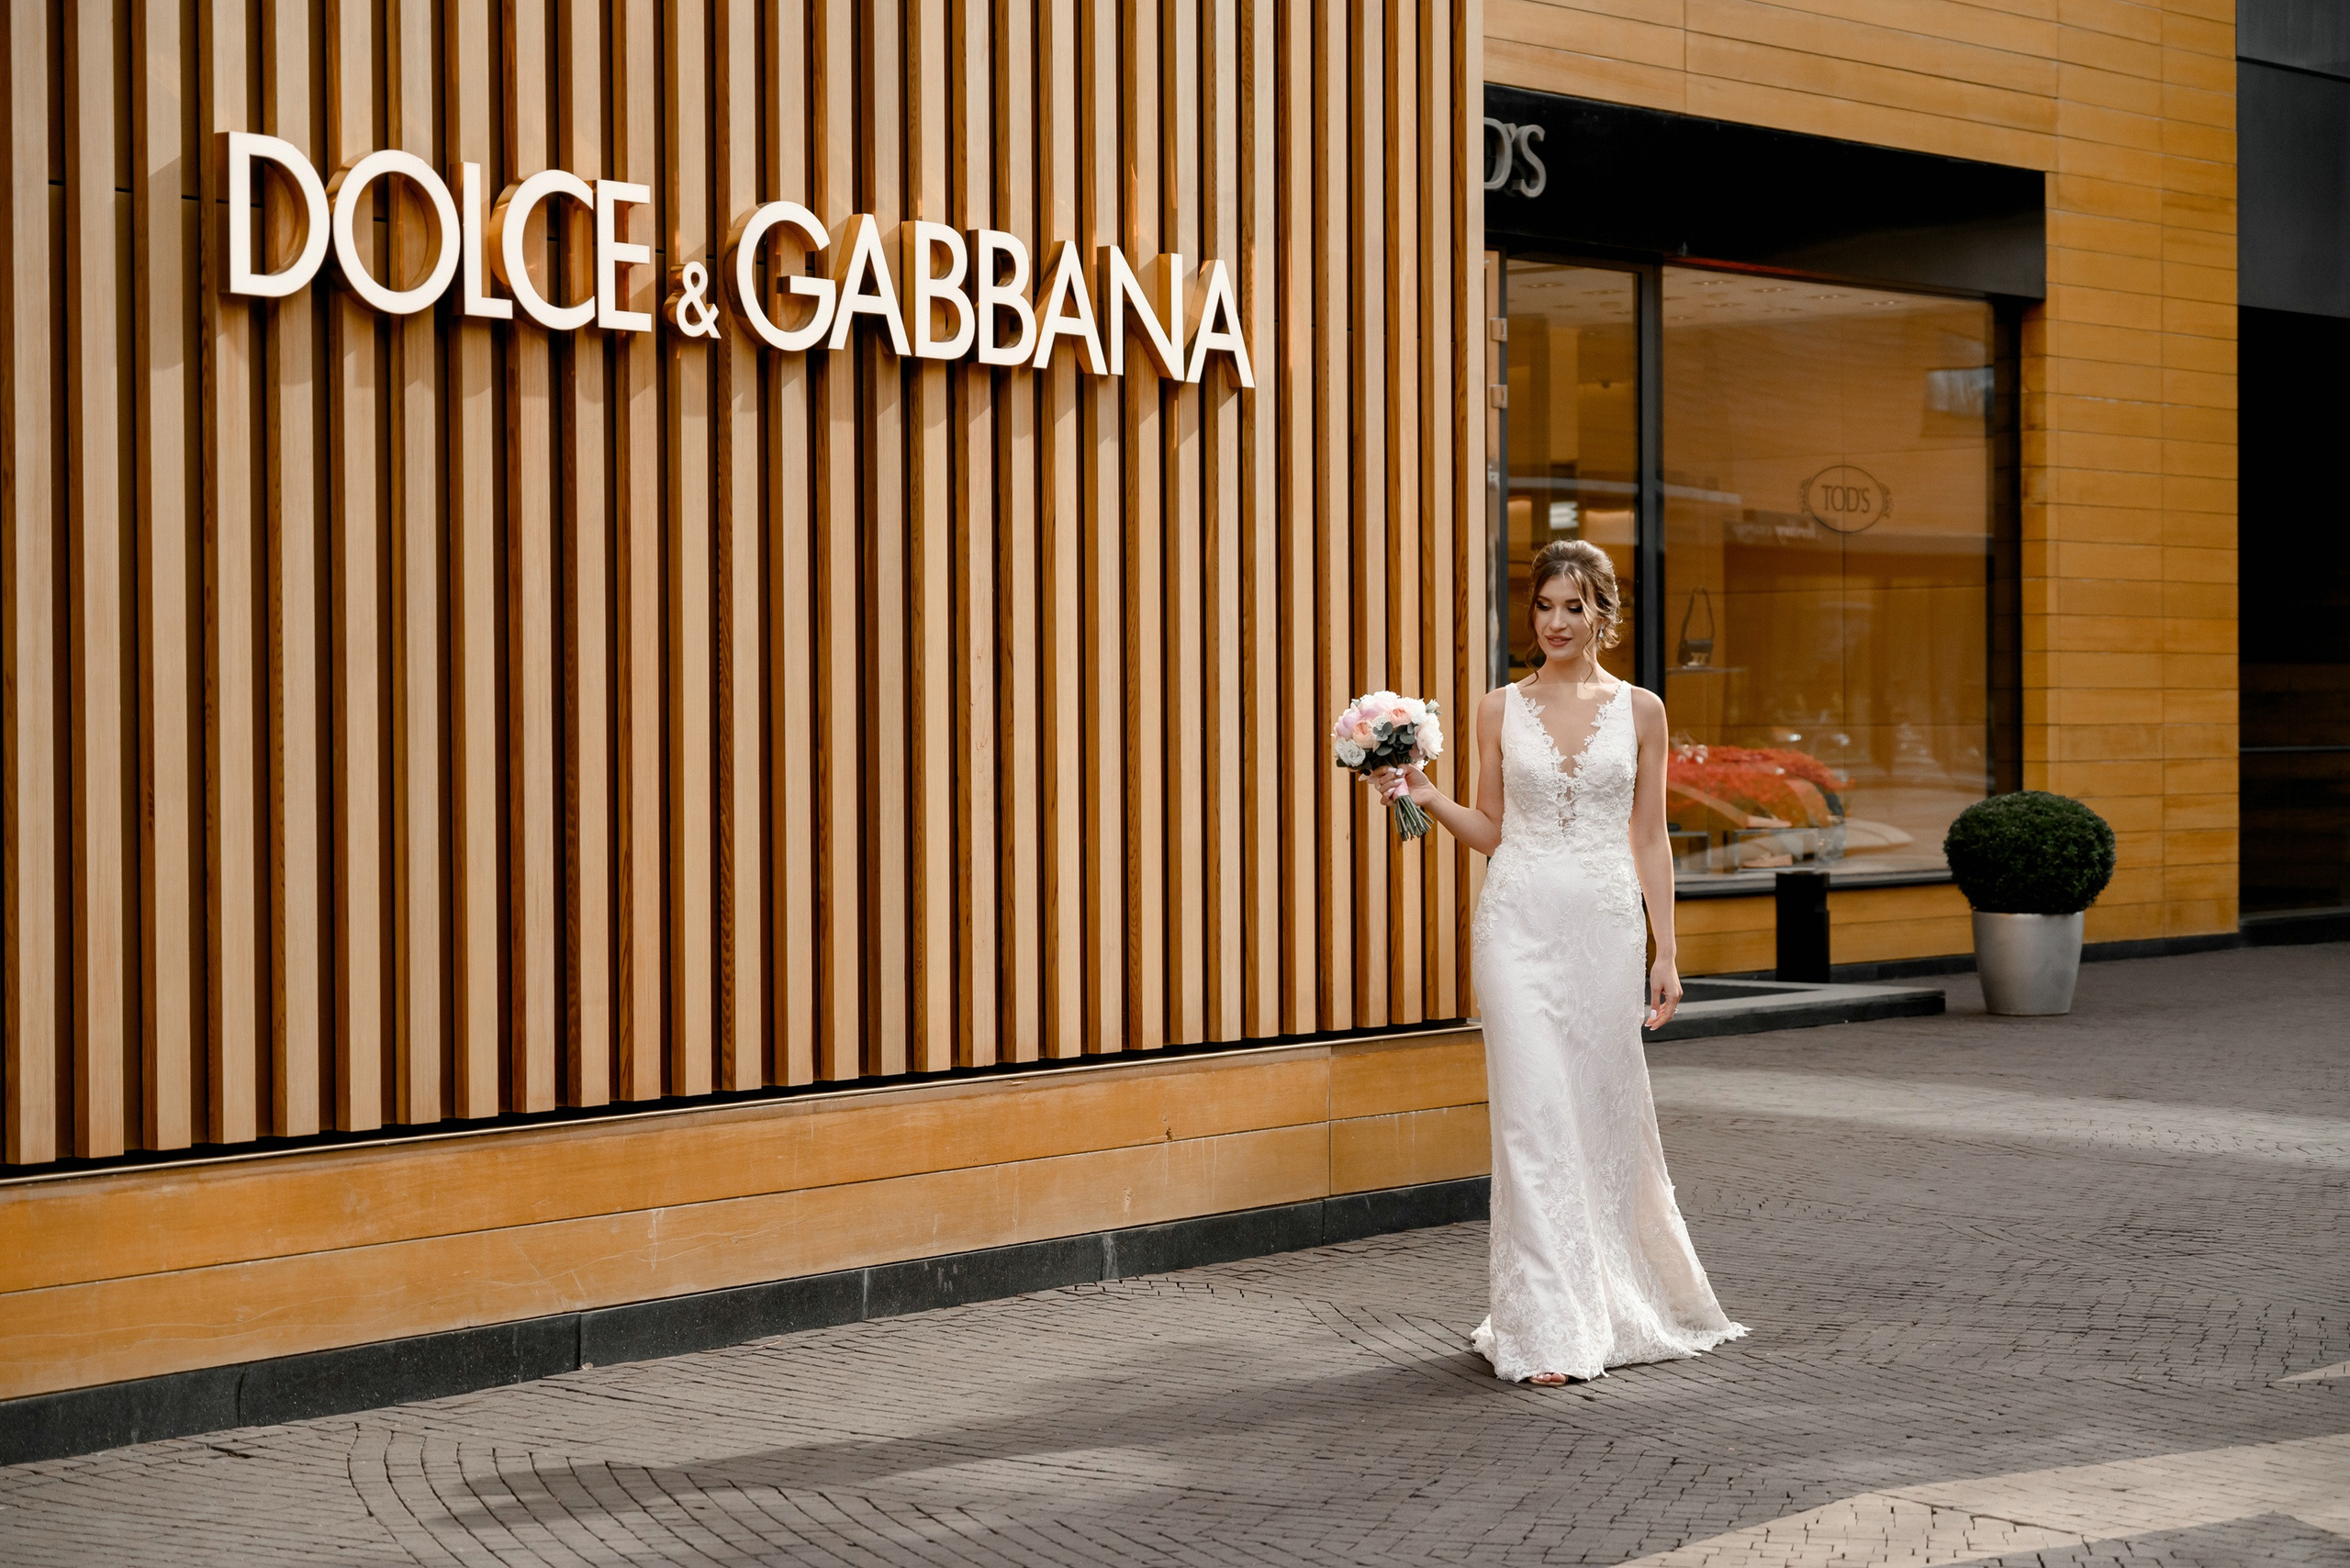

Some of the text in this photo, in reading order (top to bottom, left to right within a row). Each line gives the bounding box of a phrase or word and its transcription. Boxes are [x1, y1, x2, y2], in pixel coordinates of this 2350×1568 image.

[227, 130, 1256, 389] DOLCE & GABBANA
[1821, 485, 1870, 513] TOD'S
